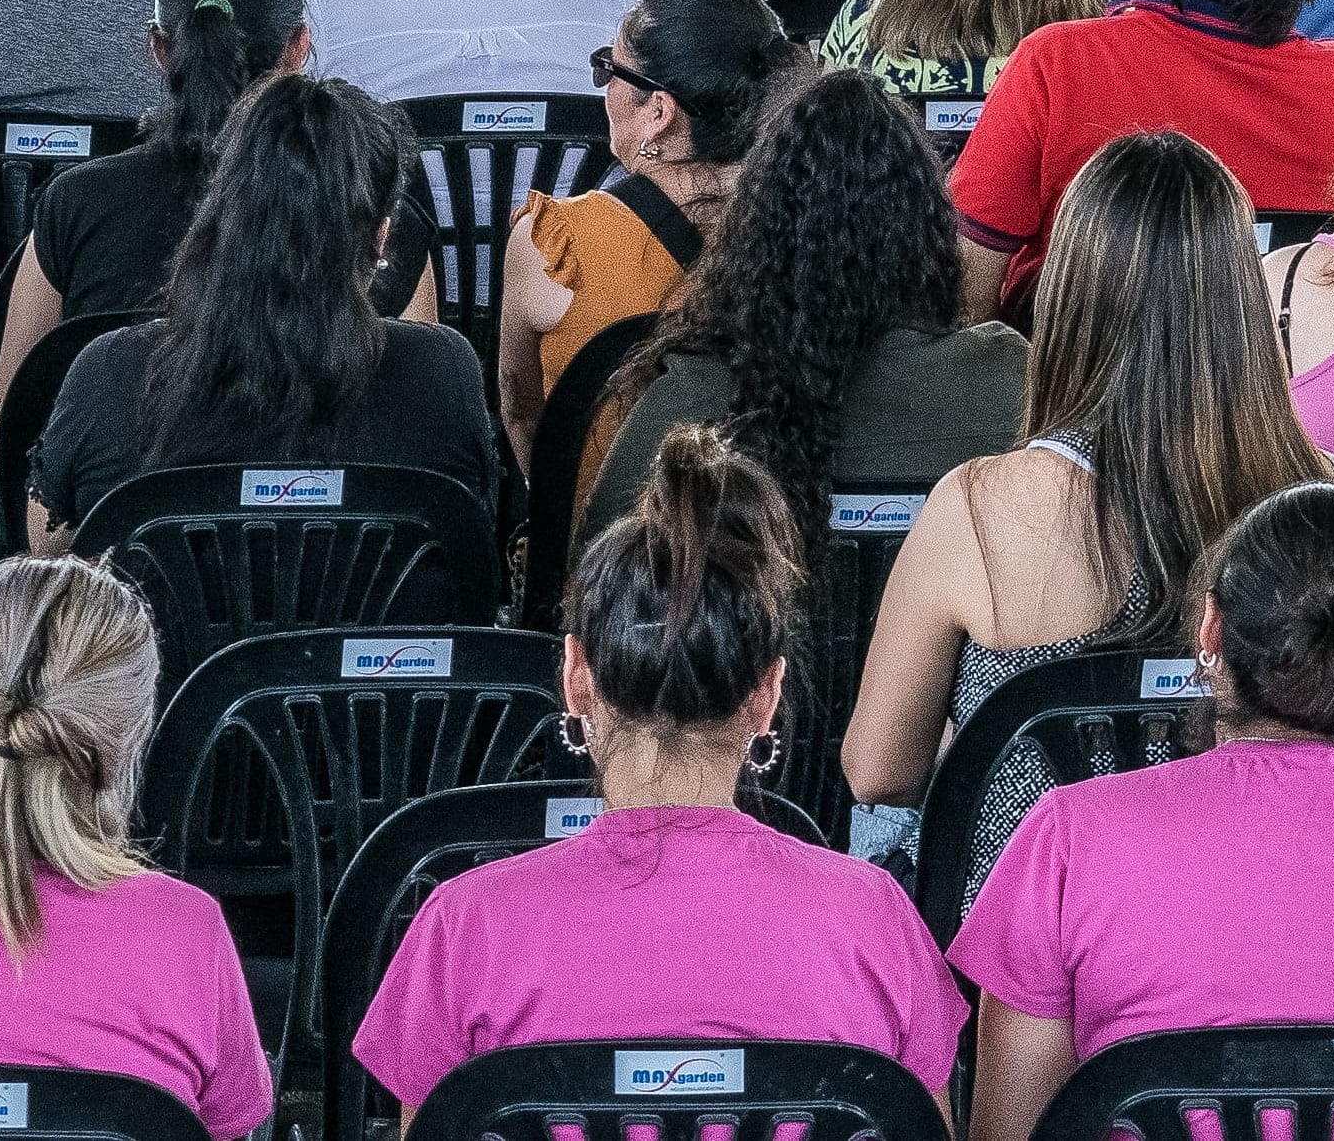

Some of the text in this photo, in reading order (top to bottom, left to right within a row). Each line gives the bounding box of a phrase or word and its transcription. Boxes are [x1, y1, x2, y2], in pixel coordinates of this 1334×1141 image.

[474, 114, 534, 125] MAXgarden
[17, 136, 79, 149] MAXgarden
[255, 484, 328, 498] MAXgarden
[839, 509, 911, 522] MAXgarden
[356, 655, 435, 669] MAXgarden
[632, 1069, 726, 1085] MAXgarden
